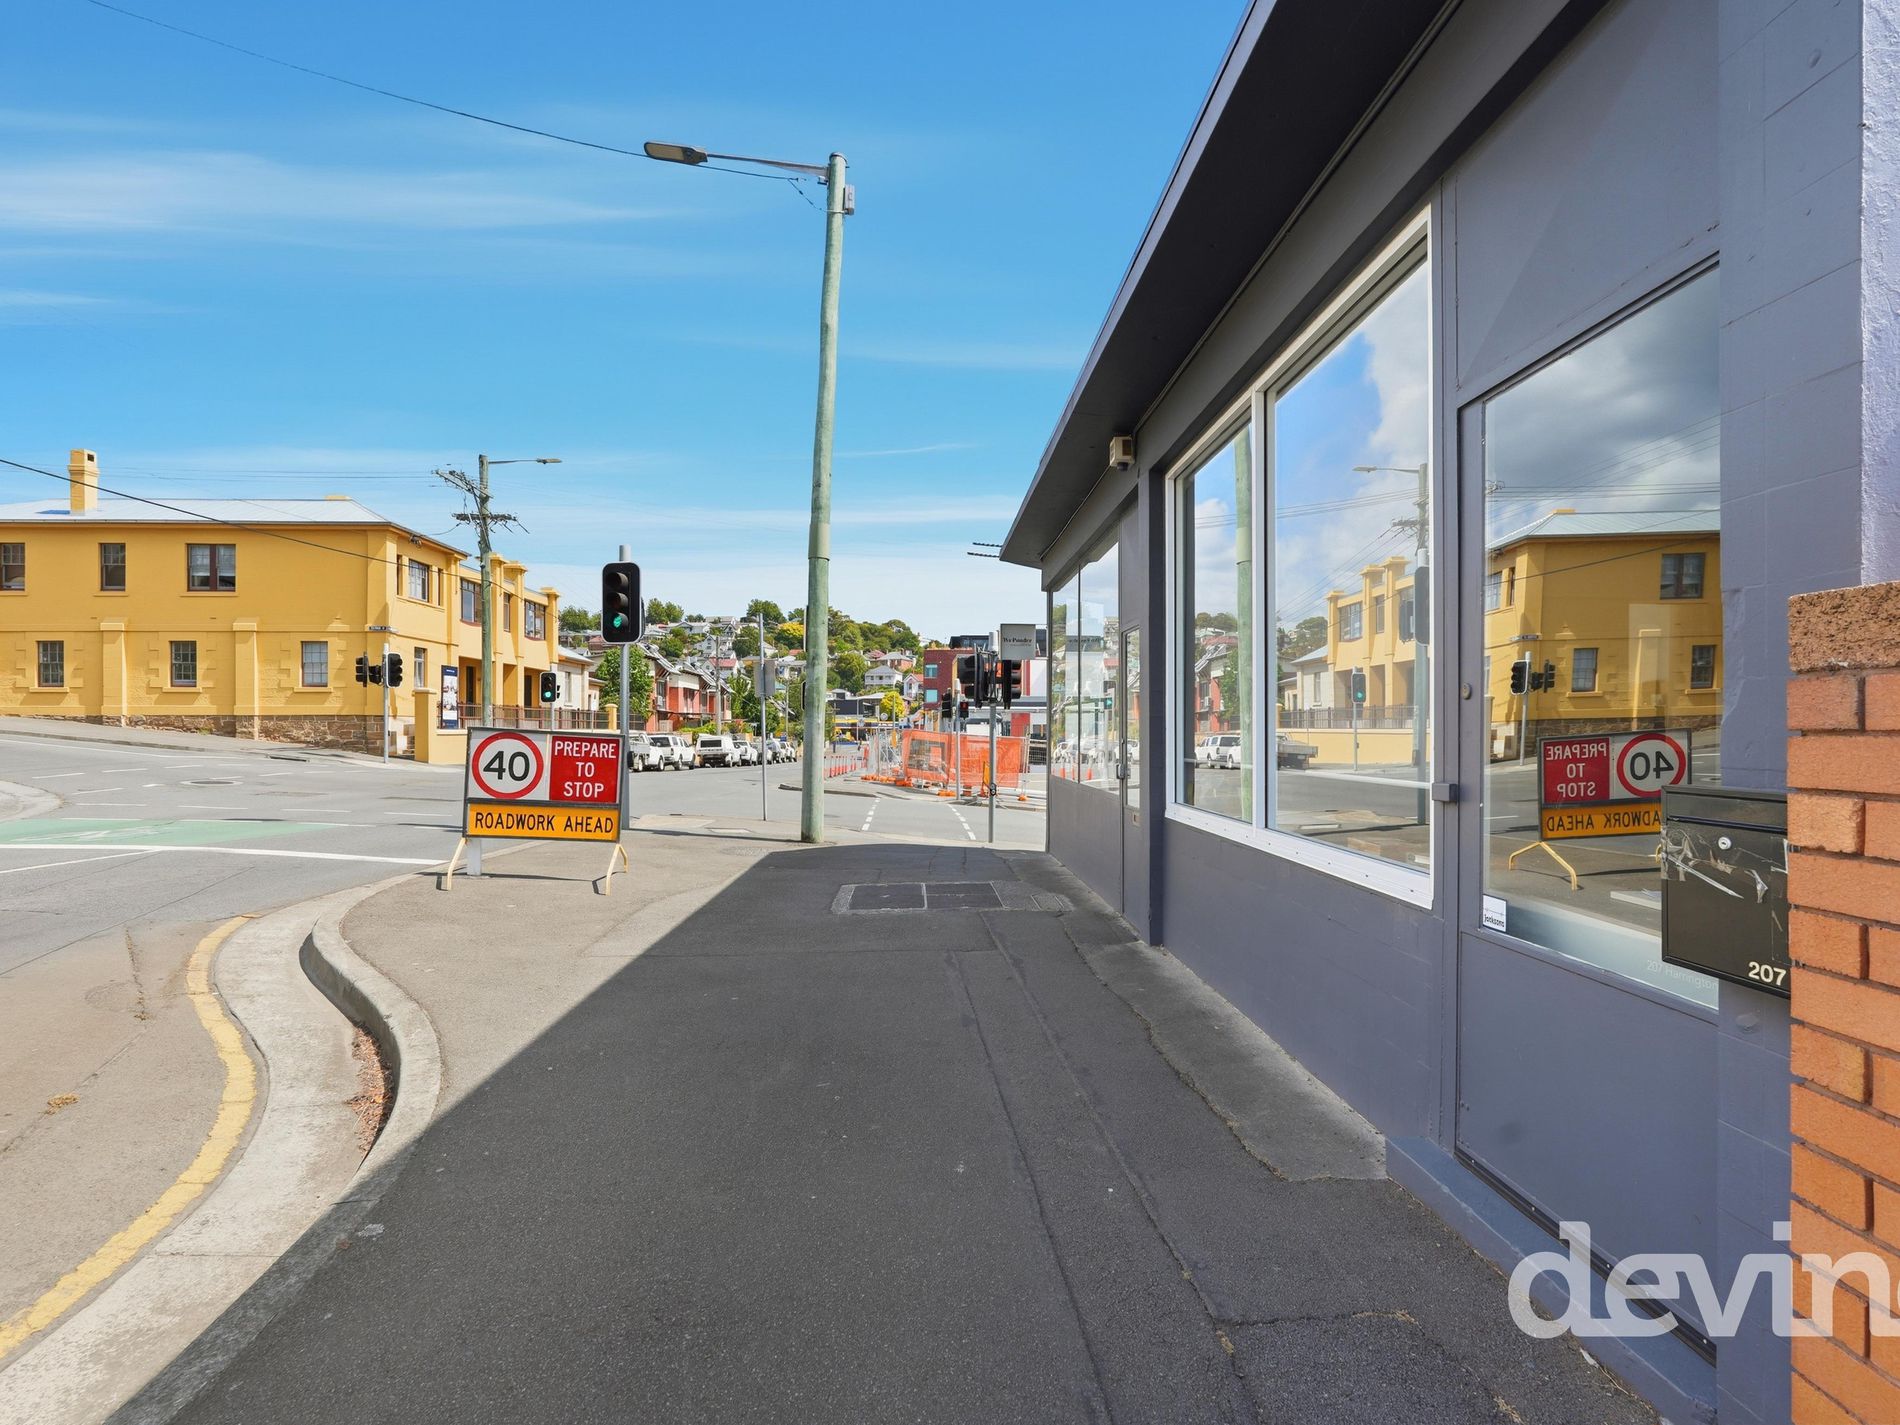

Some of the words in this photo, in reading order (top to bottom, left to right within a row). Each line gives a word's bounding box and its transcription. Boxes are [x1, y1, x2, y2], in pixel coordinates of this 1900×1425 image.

[554, 741, 617, 758] PREPARE
[482, 750, 530, 782] 40
[575, 761, 595, 778] TO
[563, 781, 604, 798] STOP
[474, 812, 556, 831] ROADWORK
[563, 816, 614, 834] AHEAD
[1647, 959, 1663, 975] 207
[1665, 965, 1719, 989] Harrington
[1748, 961, 1787, 986] 207
